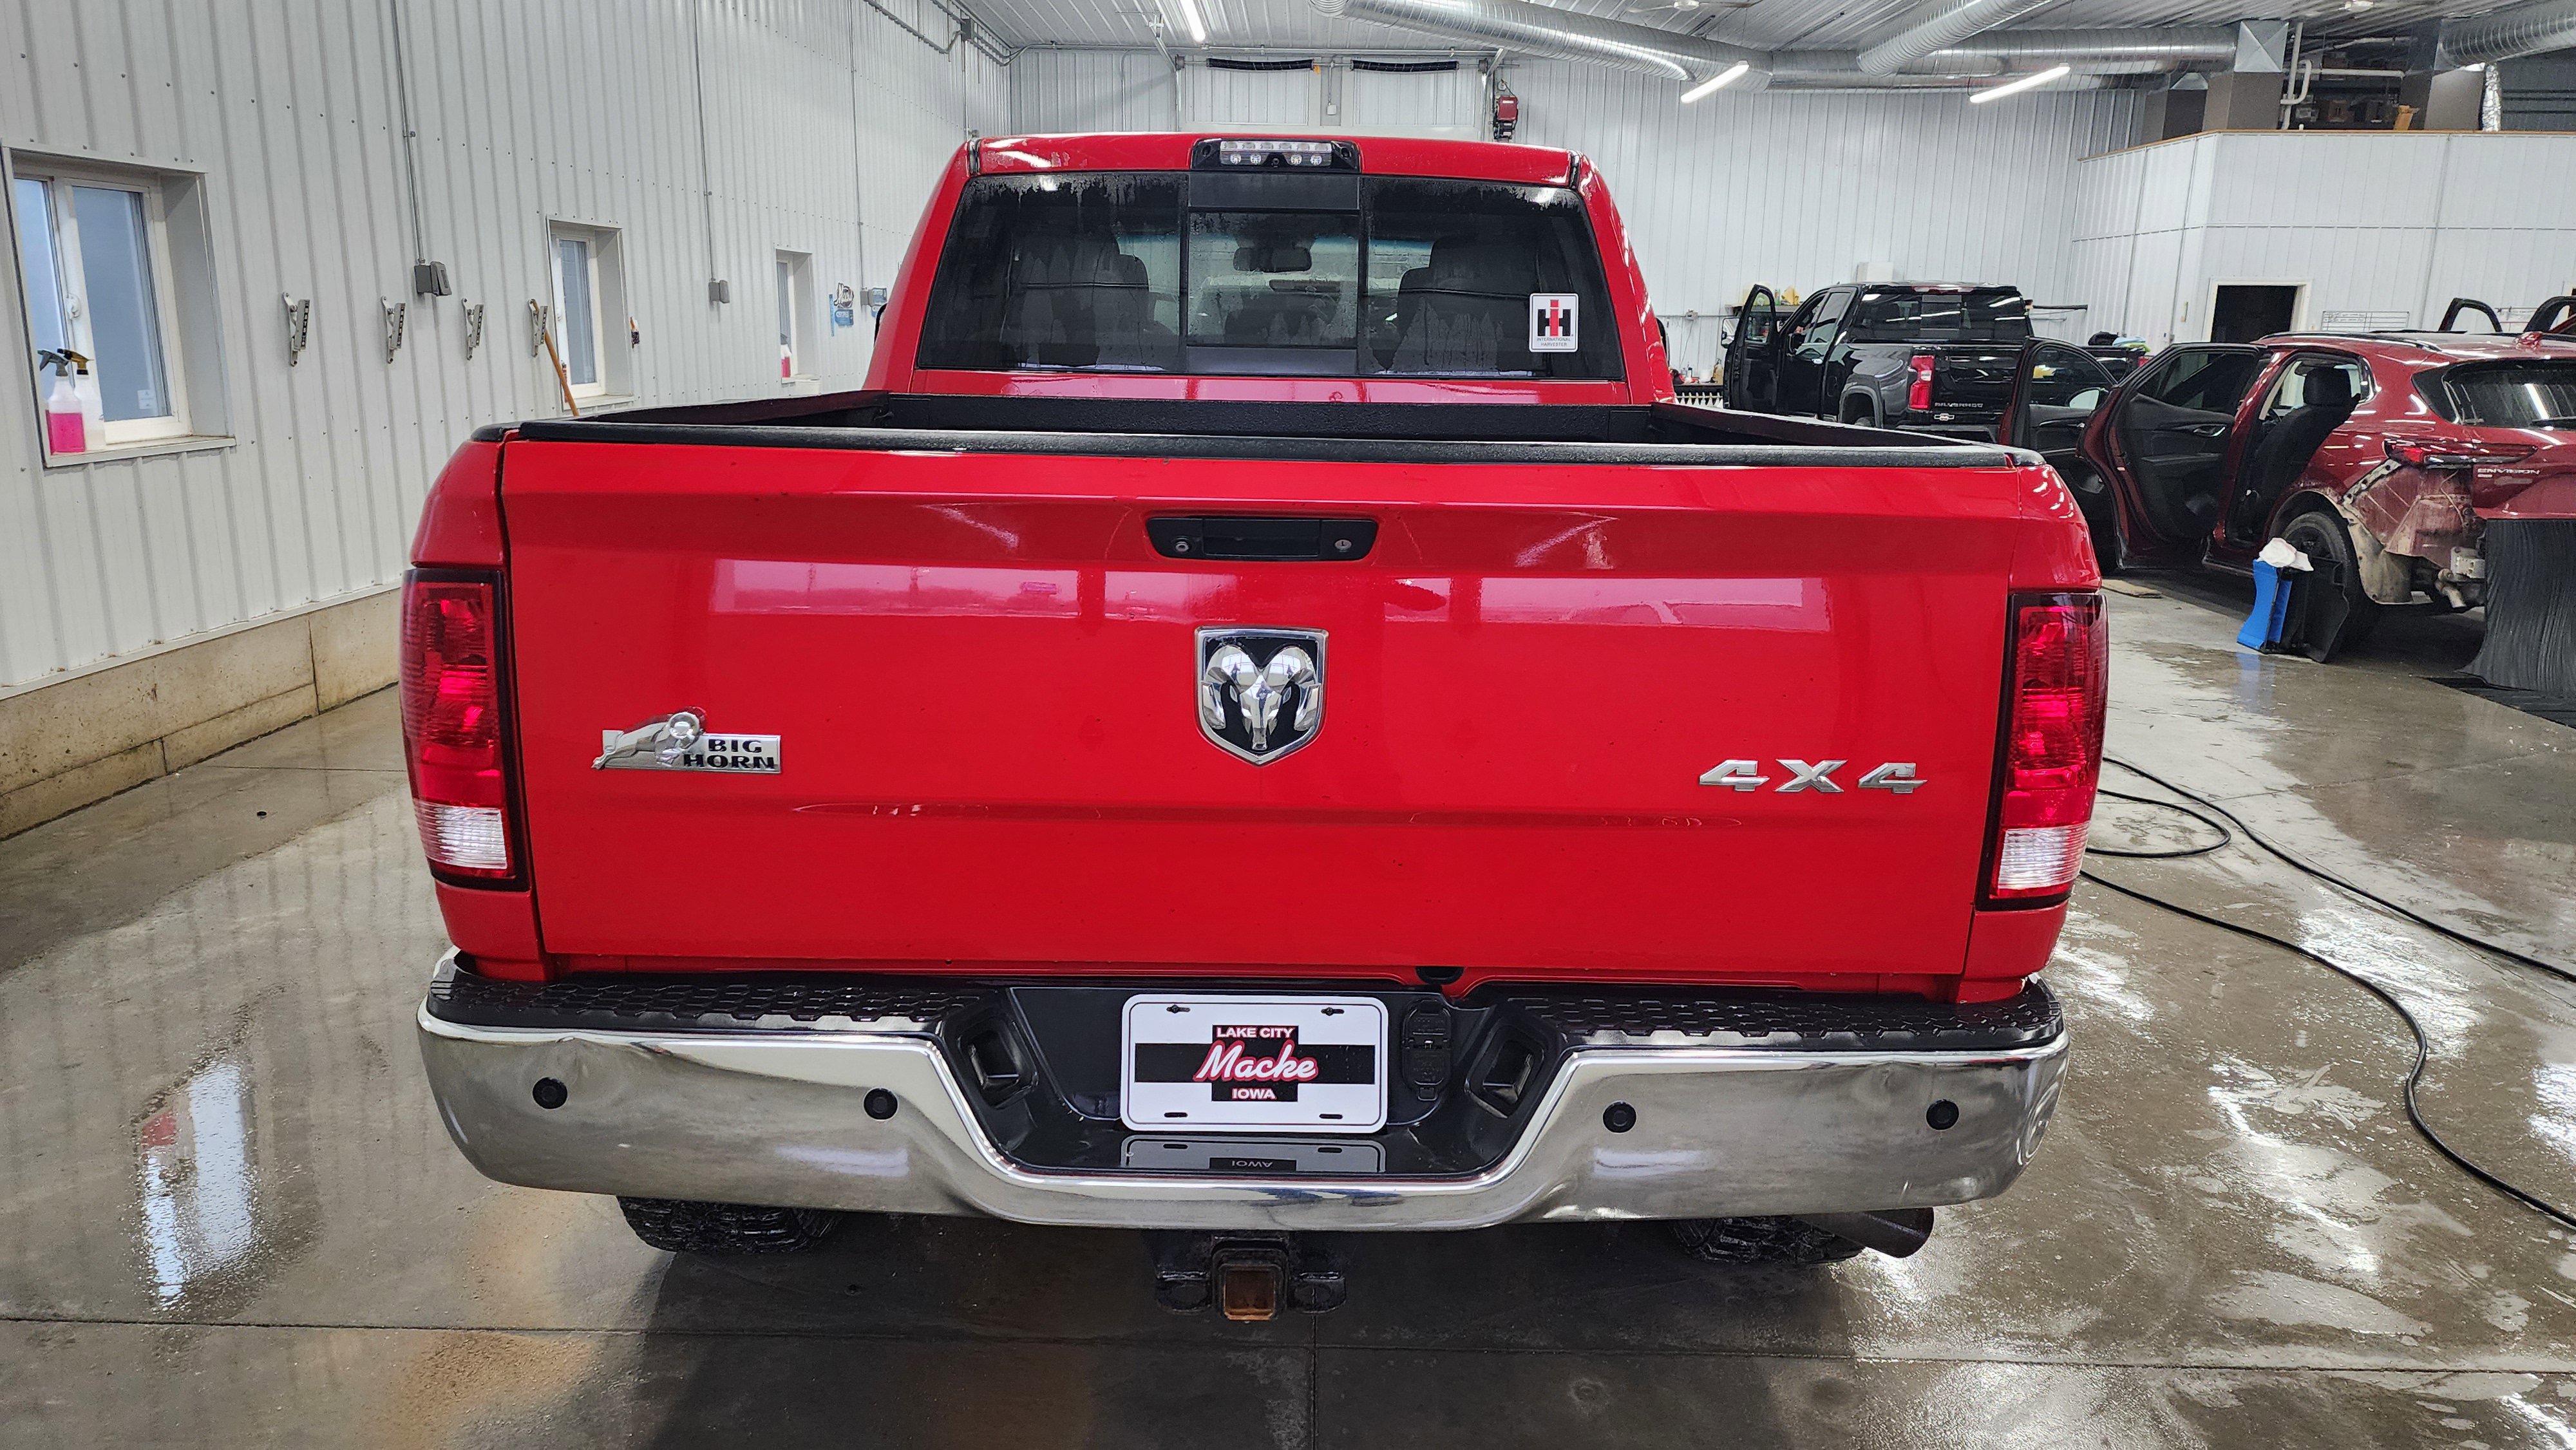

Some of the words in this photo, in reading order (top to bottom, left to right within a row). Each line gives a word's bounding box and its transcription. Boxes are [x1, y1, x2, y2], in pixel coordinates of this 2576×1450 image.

[708, 739, 762, 753] BIG
[683, 754, 775, 769] HORN
[1217, 1026, 1256, 1038] LAKE
[1259, 1027, 1294, 1039] CITY
[1193, 1040, 1318, 1082] Macke
[1231, 1088, 1277, 1100] IOWA
